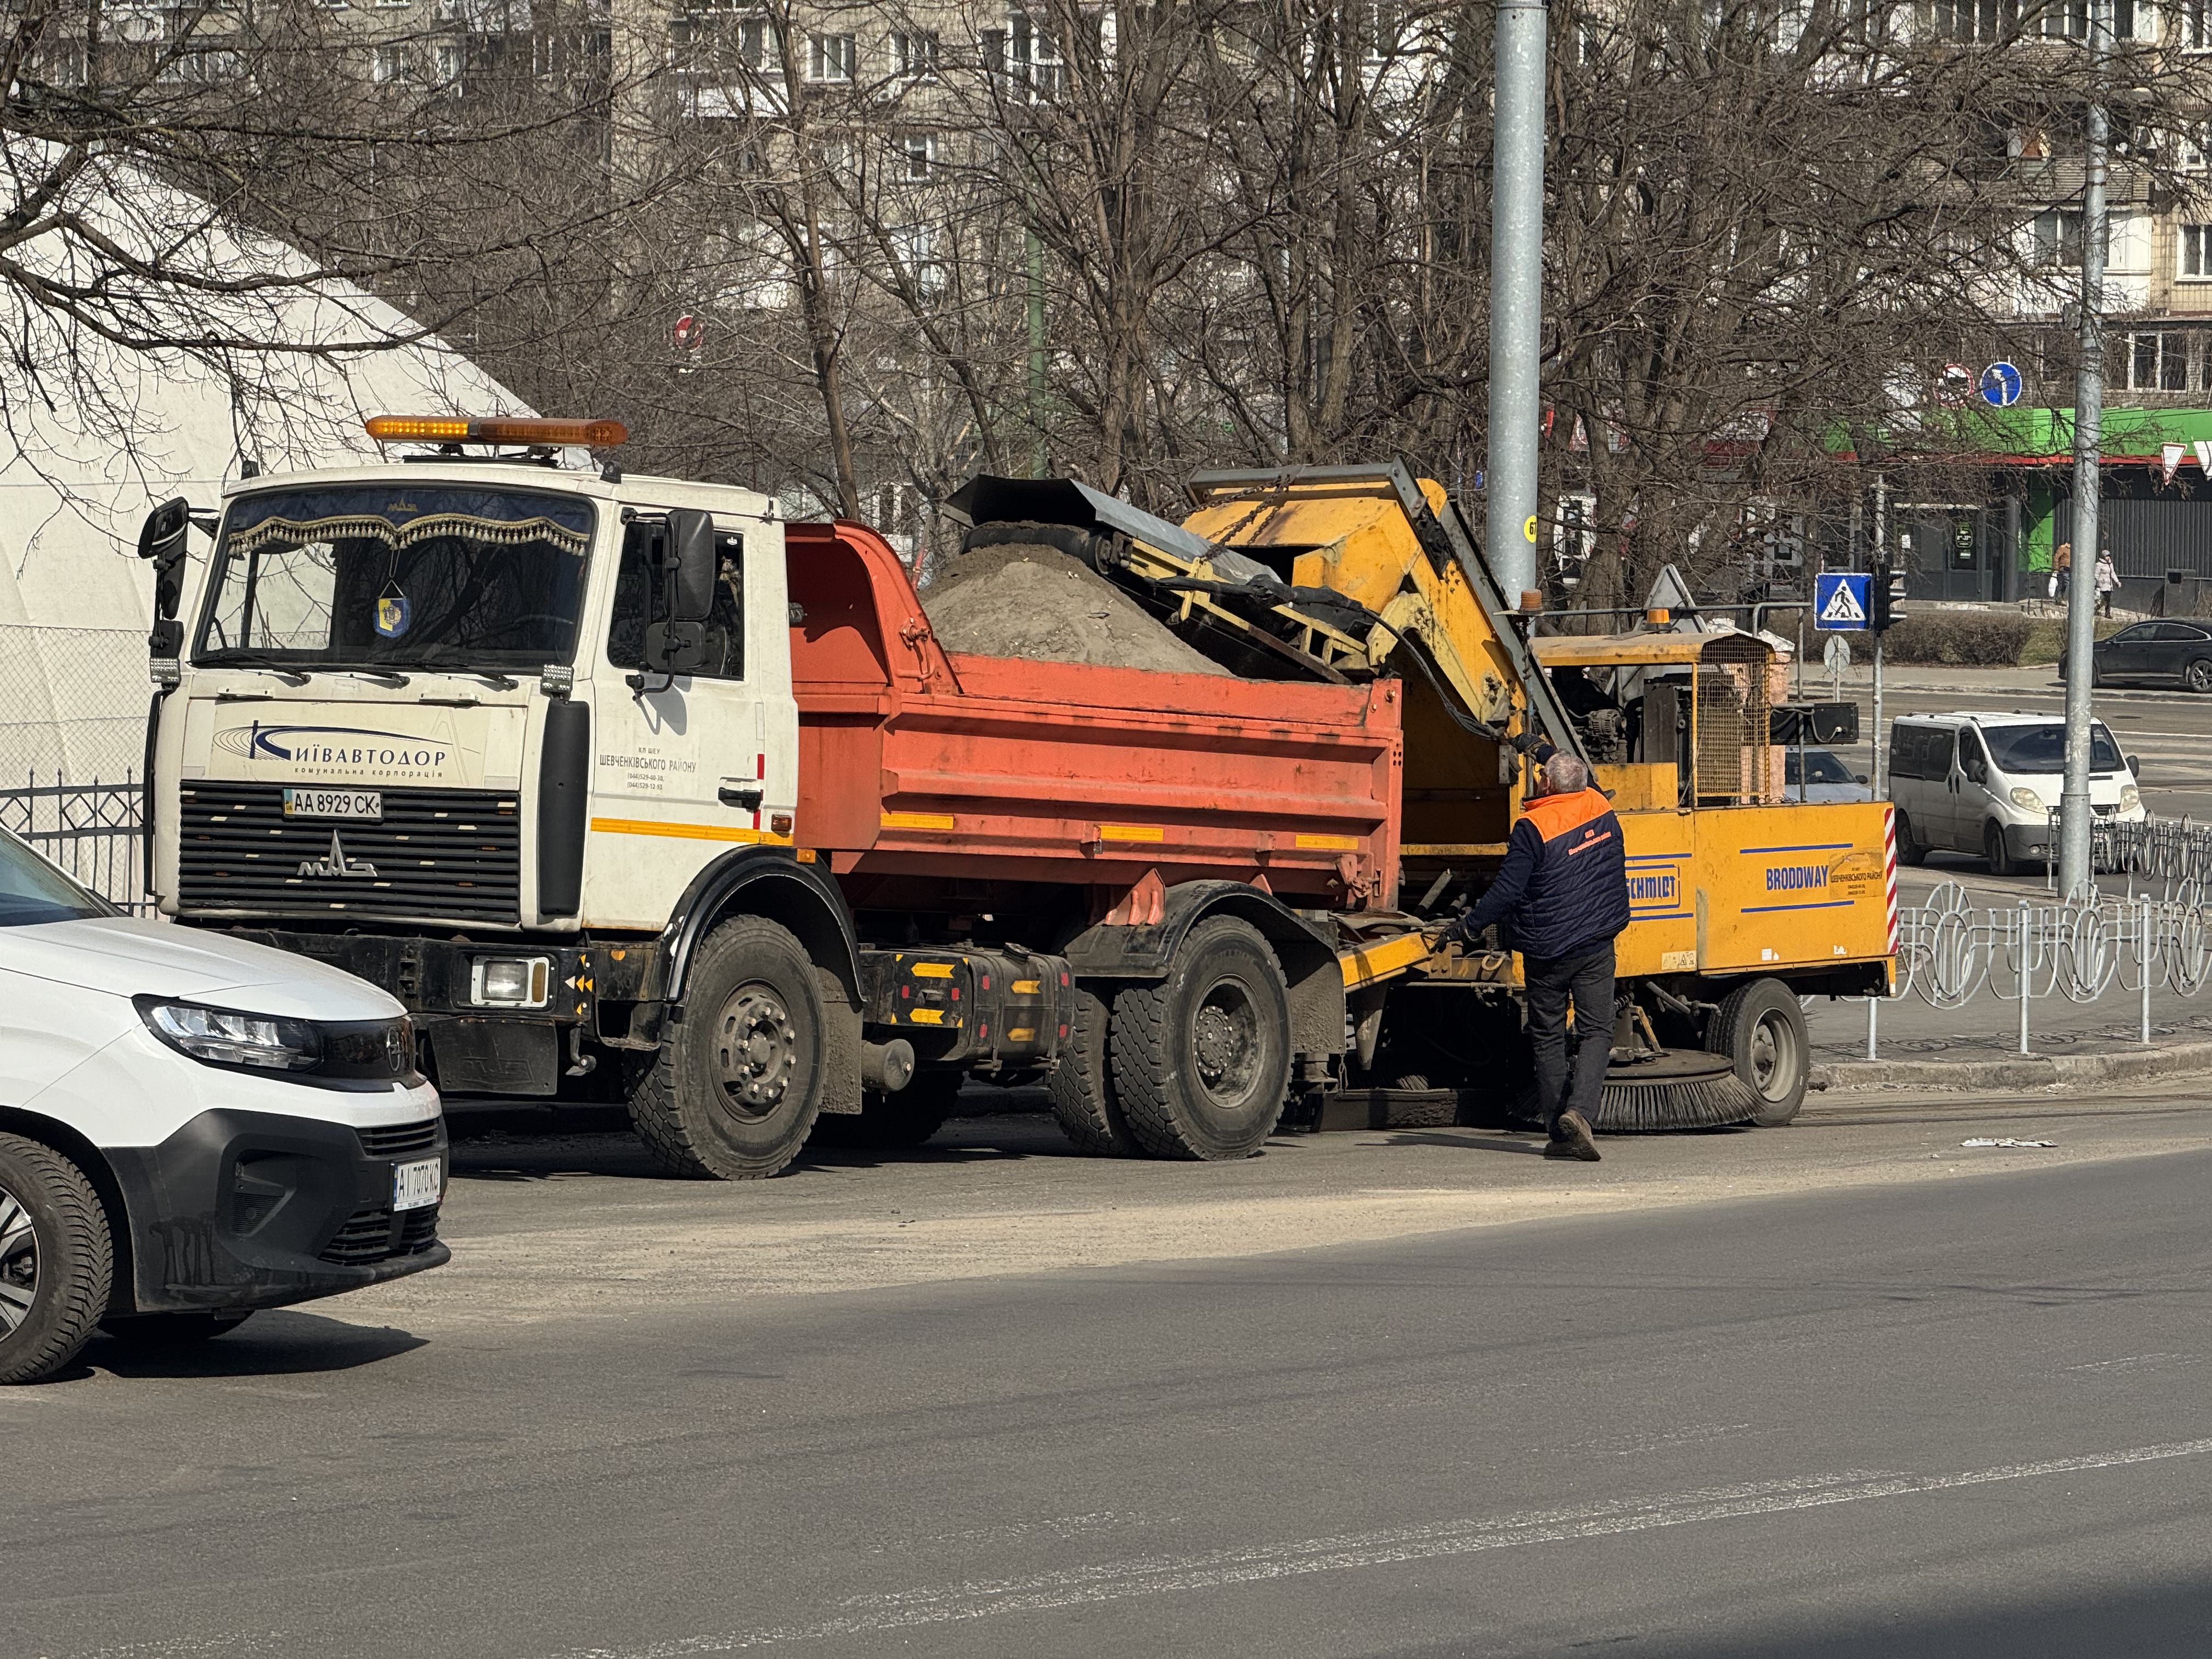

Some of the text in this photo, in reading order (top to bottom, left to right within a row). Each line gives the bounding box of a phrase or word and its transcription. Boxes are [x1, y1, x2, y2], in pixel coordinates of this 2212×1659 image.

[1530, 522, 1536, 535] 67
[295, 767, 442, 778] комунальна корпорація
[600, 754, 697, 773] ШЕВЧЕНКІВСЬКОГО РАЙОНУ
[295, 793, 377, 814] AA 8929 CK
[1766, 865, 1829, 890] BRODDWAY
[413, 1164, 428, 1197] 7070
